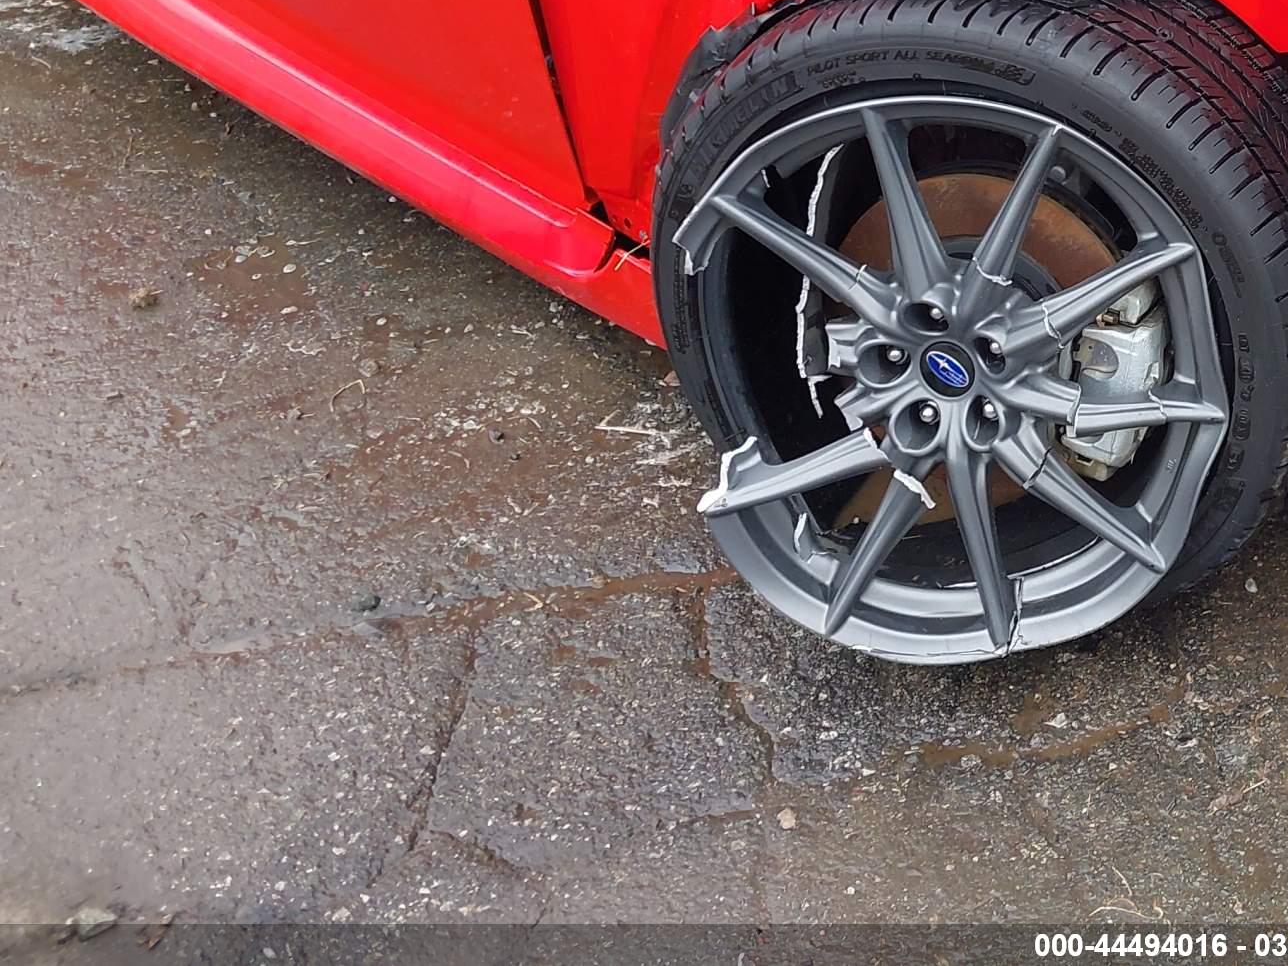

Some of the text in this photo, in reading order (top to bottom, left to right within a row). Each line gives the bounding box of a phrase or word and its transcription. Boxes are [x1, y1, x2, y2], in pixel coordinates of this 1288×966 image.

[807, 57, 841, 76] PILOT
[846, 49, 889, 65] SPORT
[893, 49, 920, 62] ALL
